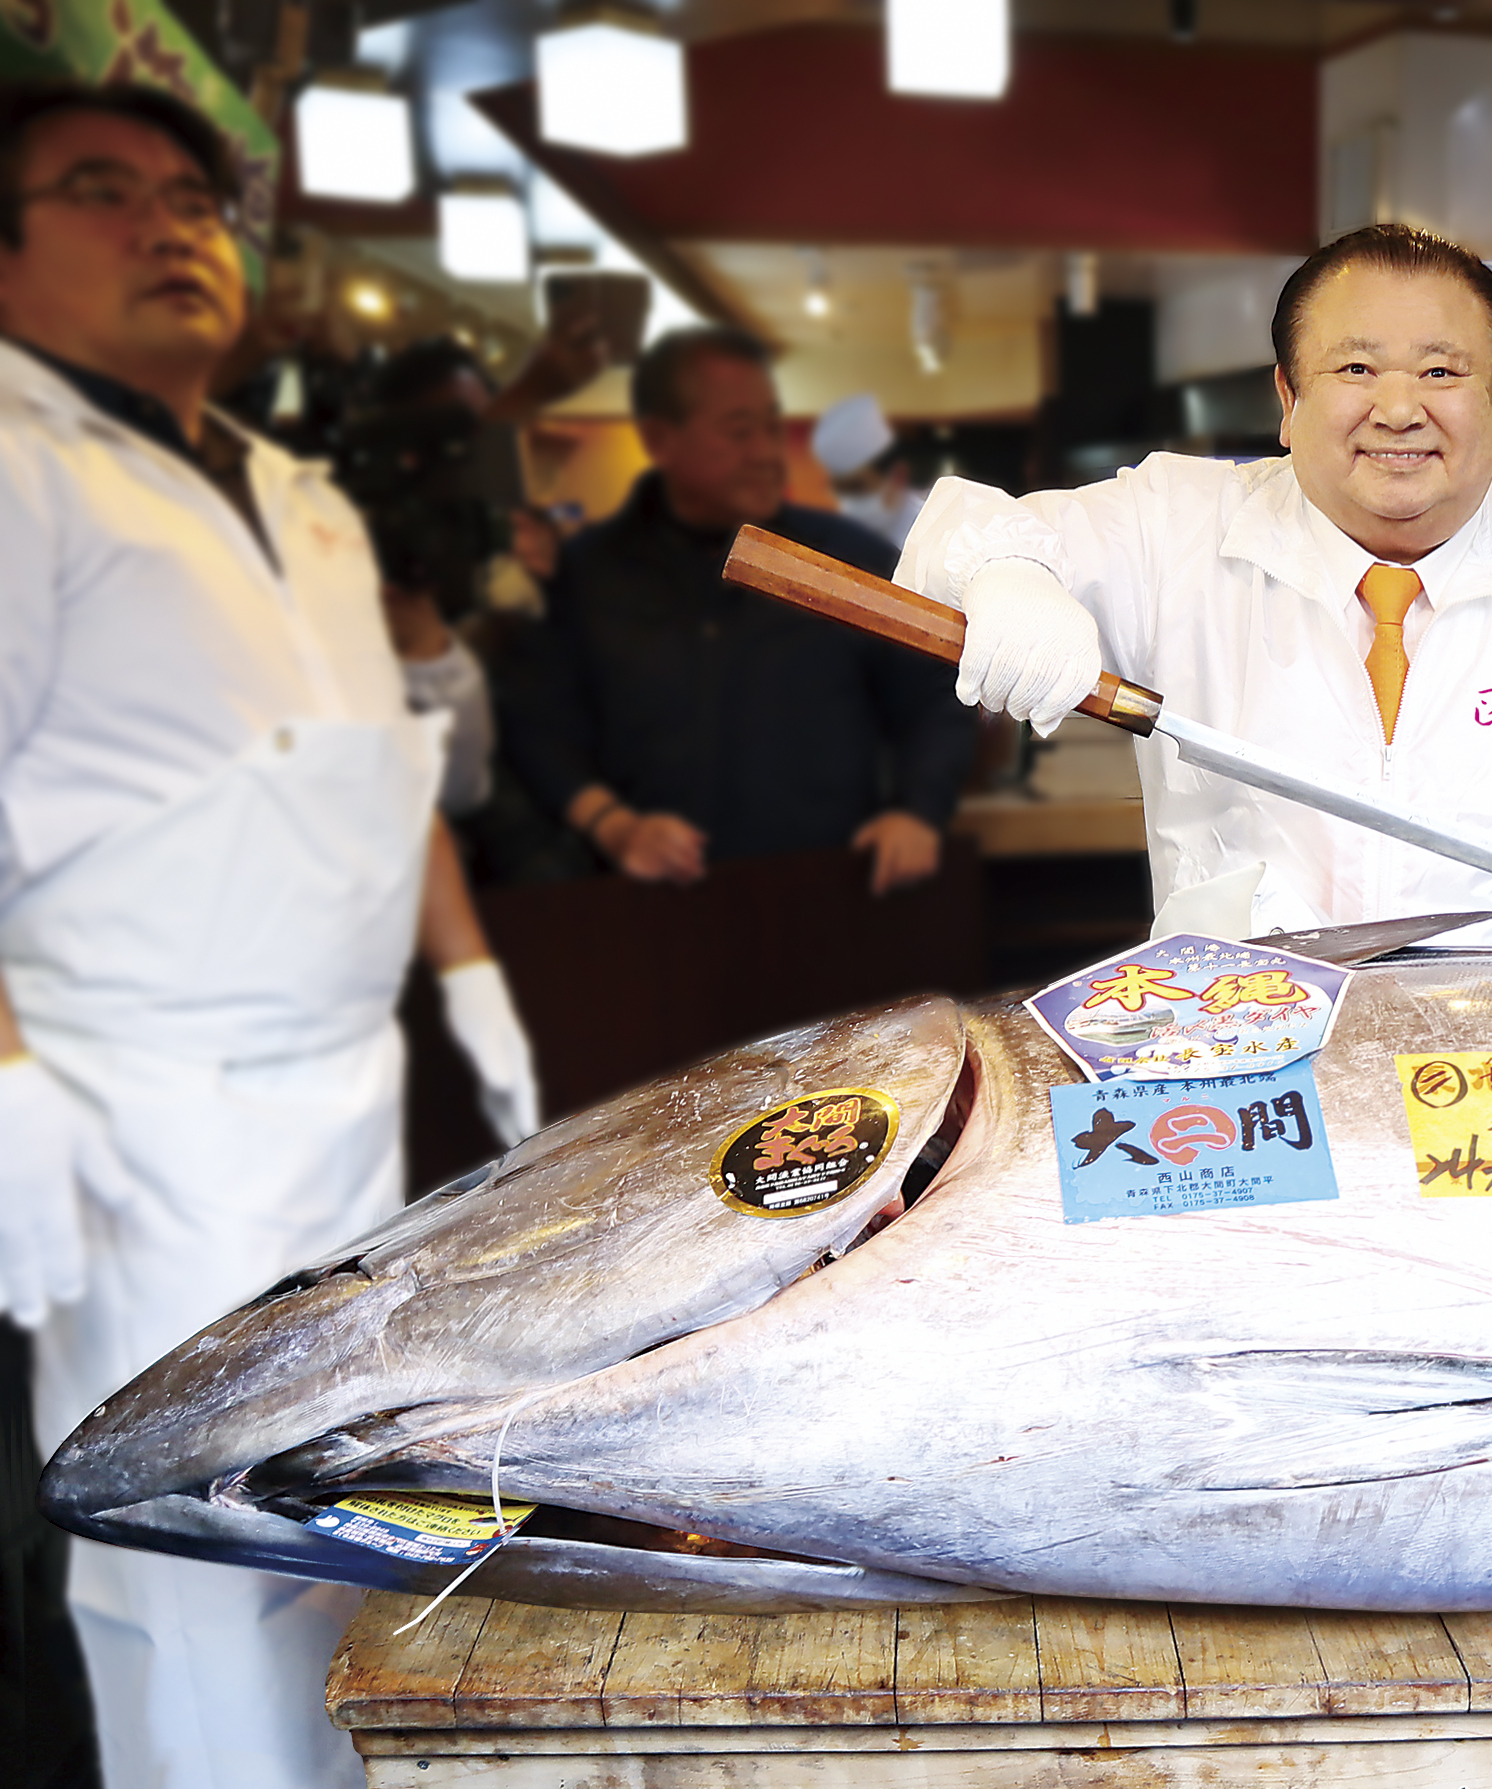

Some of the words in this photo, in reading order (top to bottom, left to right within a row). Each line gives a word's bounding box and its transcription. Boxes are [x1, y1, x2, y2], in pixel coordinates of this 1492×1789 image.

[1092, 1083, 1170, 1102] 青森県産
[760, 1096, 862, 1141] 大間
[752, 1122, 859, 1171] まぐろ
[1156, 1165, 1235, 1184] 西山商店
[1125, 1175, 1274, 1198] 青森県下北郡大間町大間平
[1153, 1195, 1172, 1203] TEL
[1153, 1202, 1174, 1211] FAX
